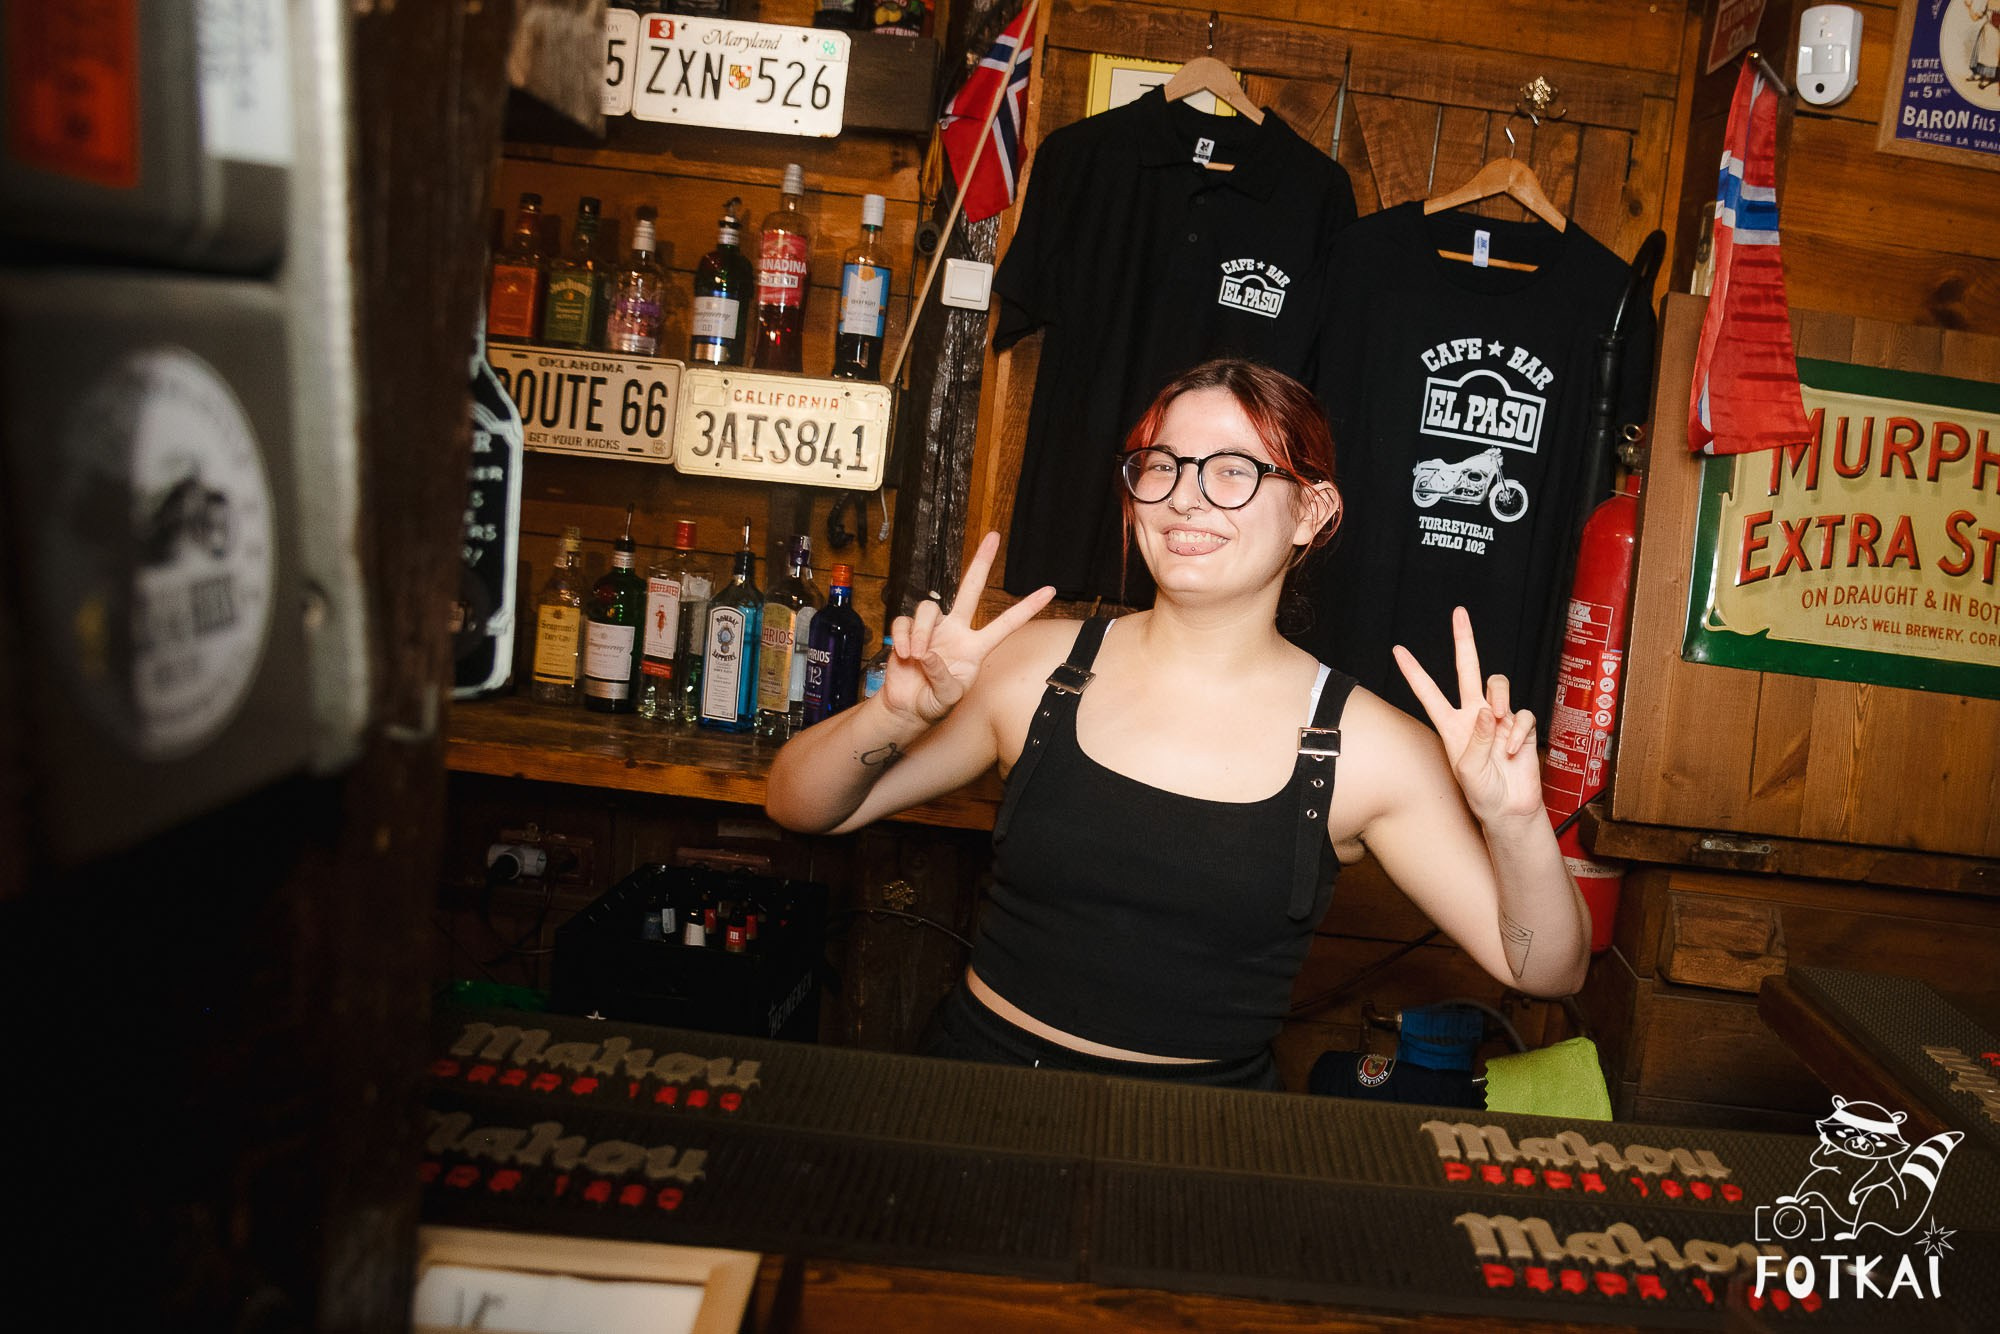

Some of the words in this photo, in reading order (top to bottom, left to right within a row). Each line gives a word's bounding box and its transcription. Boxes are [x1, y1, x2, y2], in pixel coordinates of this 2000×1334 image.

[657, 21, 671, 38] 3
[702, 29, 783, 54] Maryland
[822, 41, 836, 55] 96
[645, 46, 725, 101] ZXN
[755, 57, 831, 110] 526
[1923, 85, 1933, 99] 5
[1902, 105, 1970, 129] BARON
[1971, 114, 1996, 132] FILS
[1220, 258, 1256, 275] CAFE
[1265, 264, 1290, 288] BAR
[1222, 281, 1242, 305] EL
[1242, 287, 1281, 313] PASO
[539, 357, 625, 374] OKLAHOMA
[1420, 337, 1483, 374] CAFE
[1506, 346, 1554, 392] BAR
[621, 378, 670, 439] 66
[733, 388, 840, 410] CALIFORNIA
[1426, 388, 1461, 430] EL
[1463, 394, 1539, 442] PASO
[528, 431, 546, 444] GET
[549, 434, 583, 447] YOUR
[587, 438, 621, 452] KICKS
[691, 410, 869, 473] 3AIS841
[1419, 516, 1495, 546] TORREVIEJA
[1421, 531, 1463, 553] APOLO
[1465, 538, 1486, 556] 102
[1735, 510, 1922, 587] EXTRA
[650, 582, 680, 599] BEEFEATER
[1801, 587, 1828, 609] ON
[1833, 585, 1918, 610] DRAUGHT
[1924, 589, 1937, 610] &
[1943, 592, 1961, 614] IN
[762, 627, 794, 646] ARIOS
[1825, 613, 1867, 630] LADY'S
[1873, 621, 1901, 636] WELL
[1969, 632, 2000, 648] COR
[1419, 1120, 1732, 1180] Mahou
